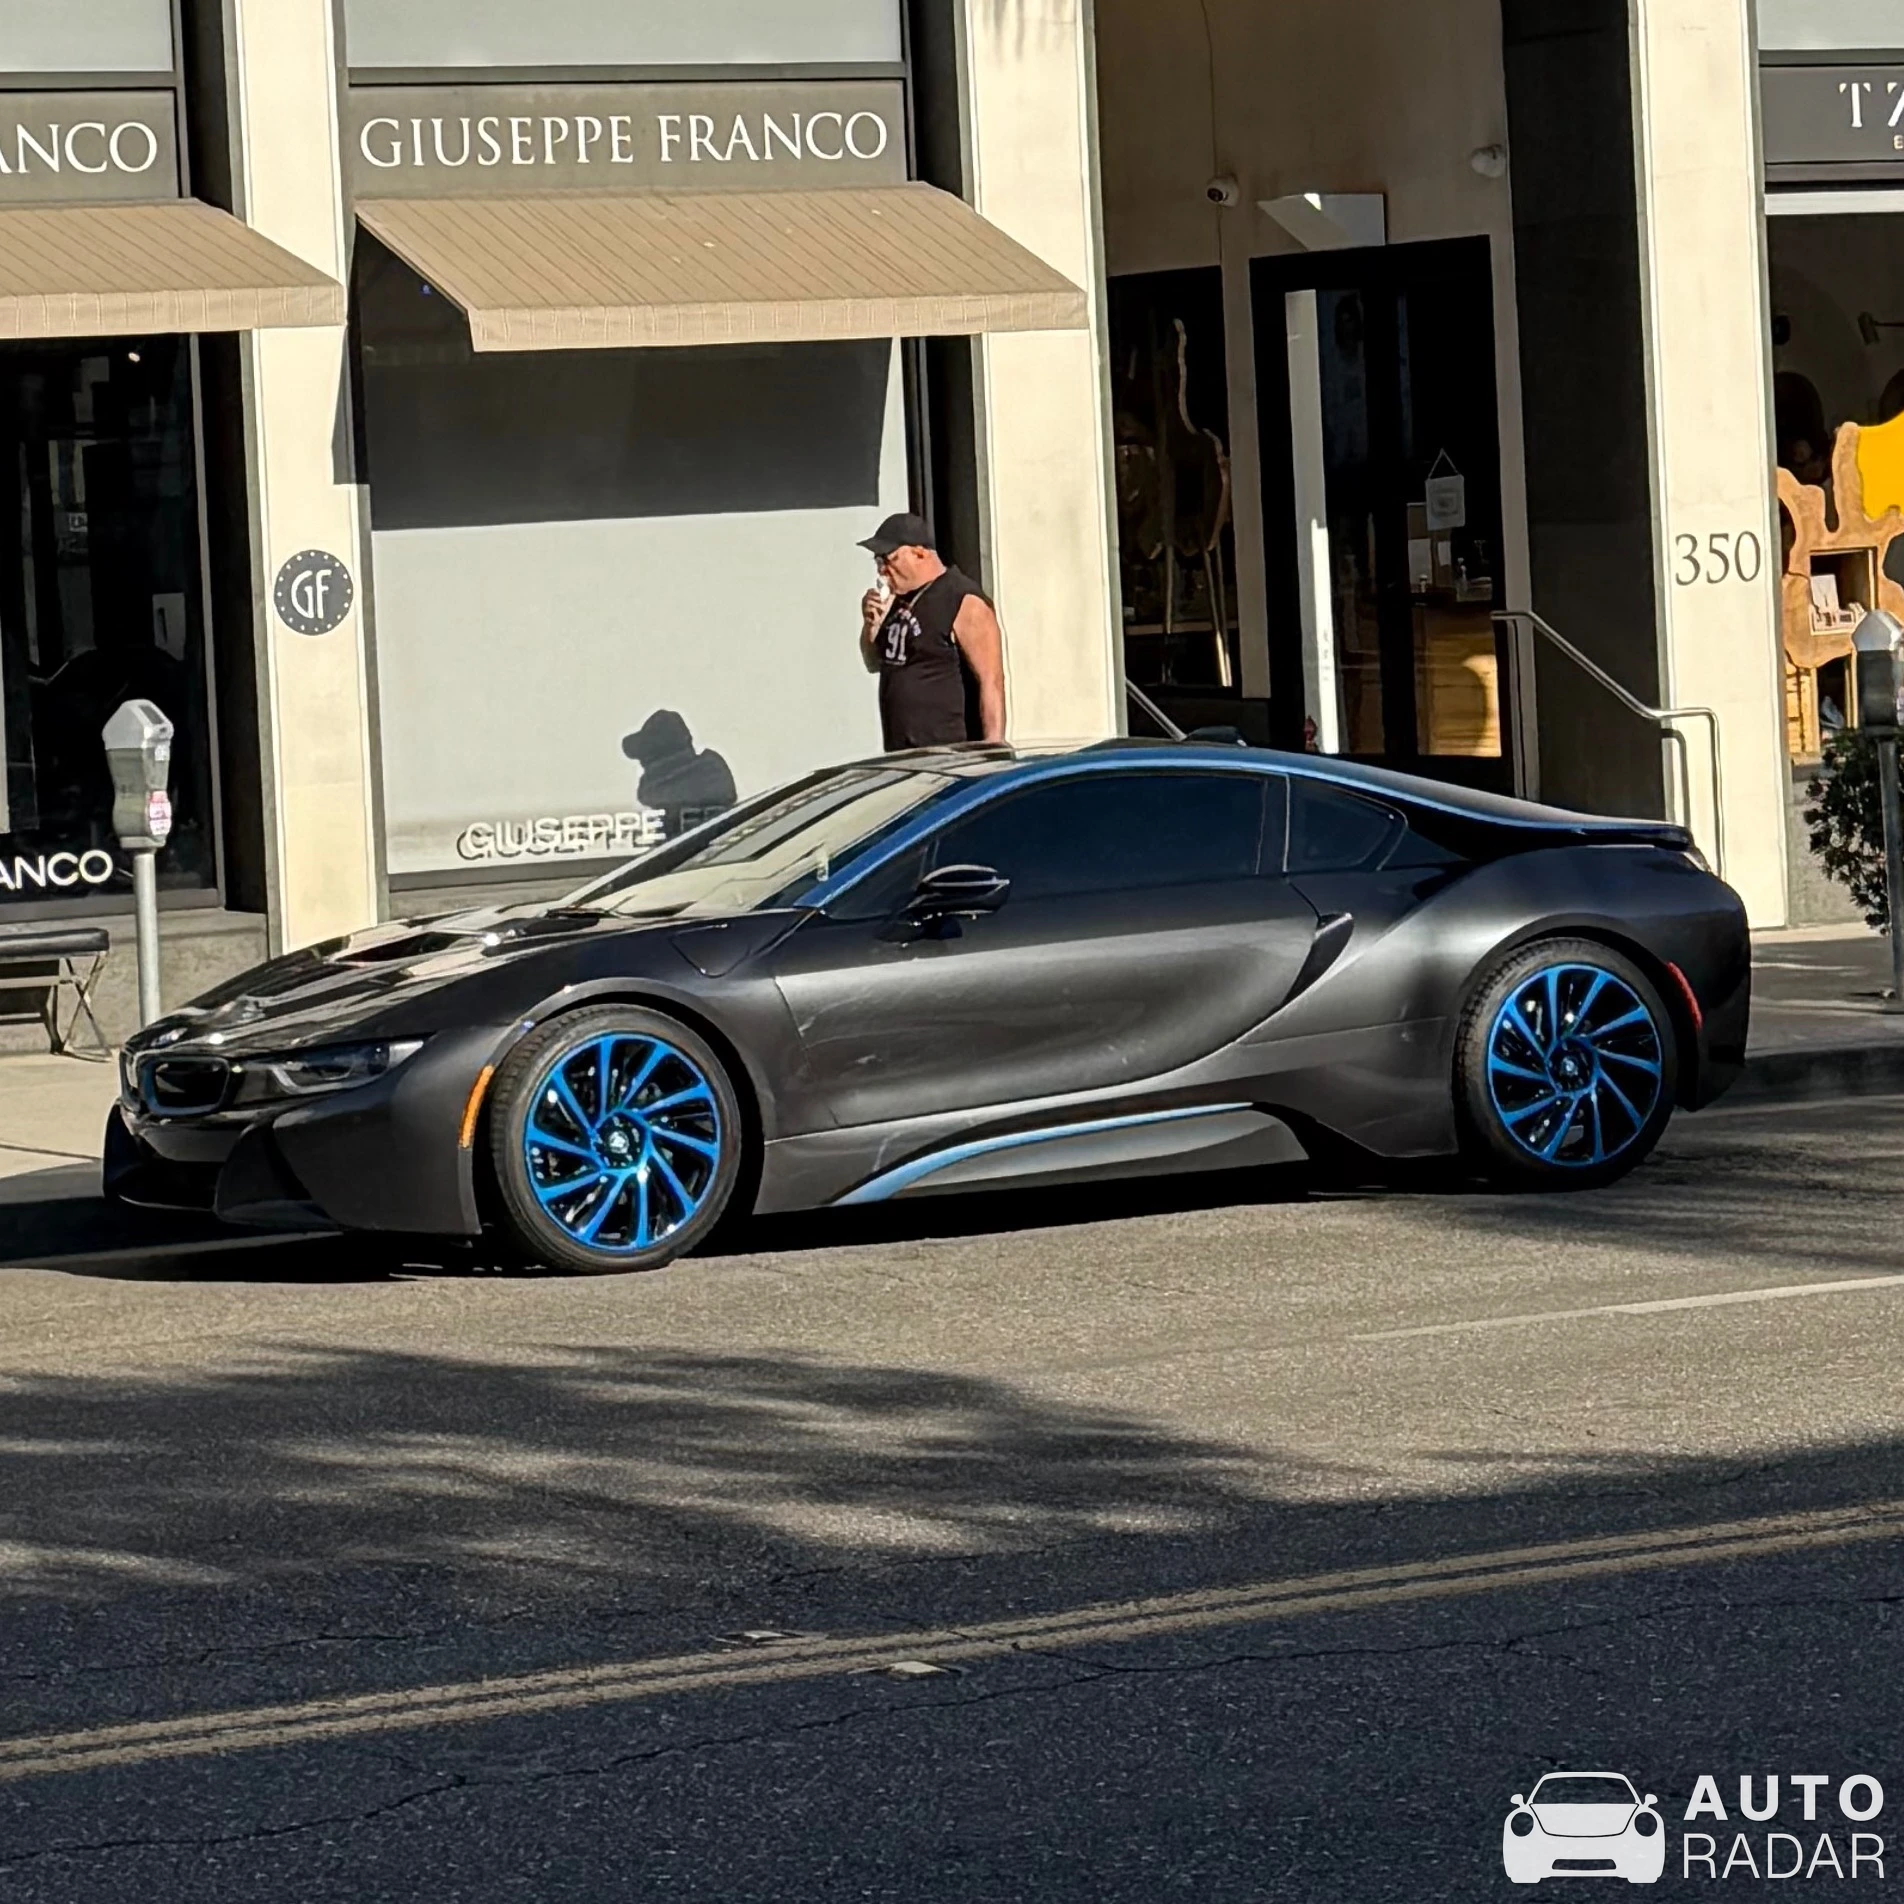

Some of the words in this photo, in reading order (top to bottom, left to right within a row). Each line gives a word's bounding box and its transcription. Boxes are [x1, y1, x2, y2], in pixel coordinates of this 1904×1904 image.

[360, 115, 634, 168] GIUSEPPE
[657, 111, 888, 163] FRANCO
[1675, 530, 1761, 586] 350
[291, 569, 332, 619] GF
[885, 623, 908, 660] 91
[463, 808, 666, 851] GIUSEPPE
